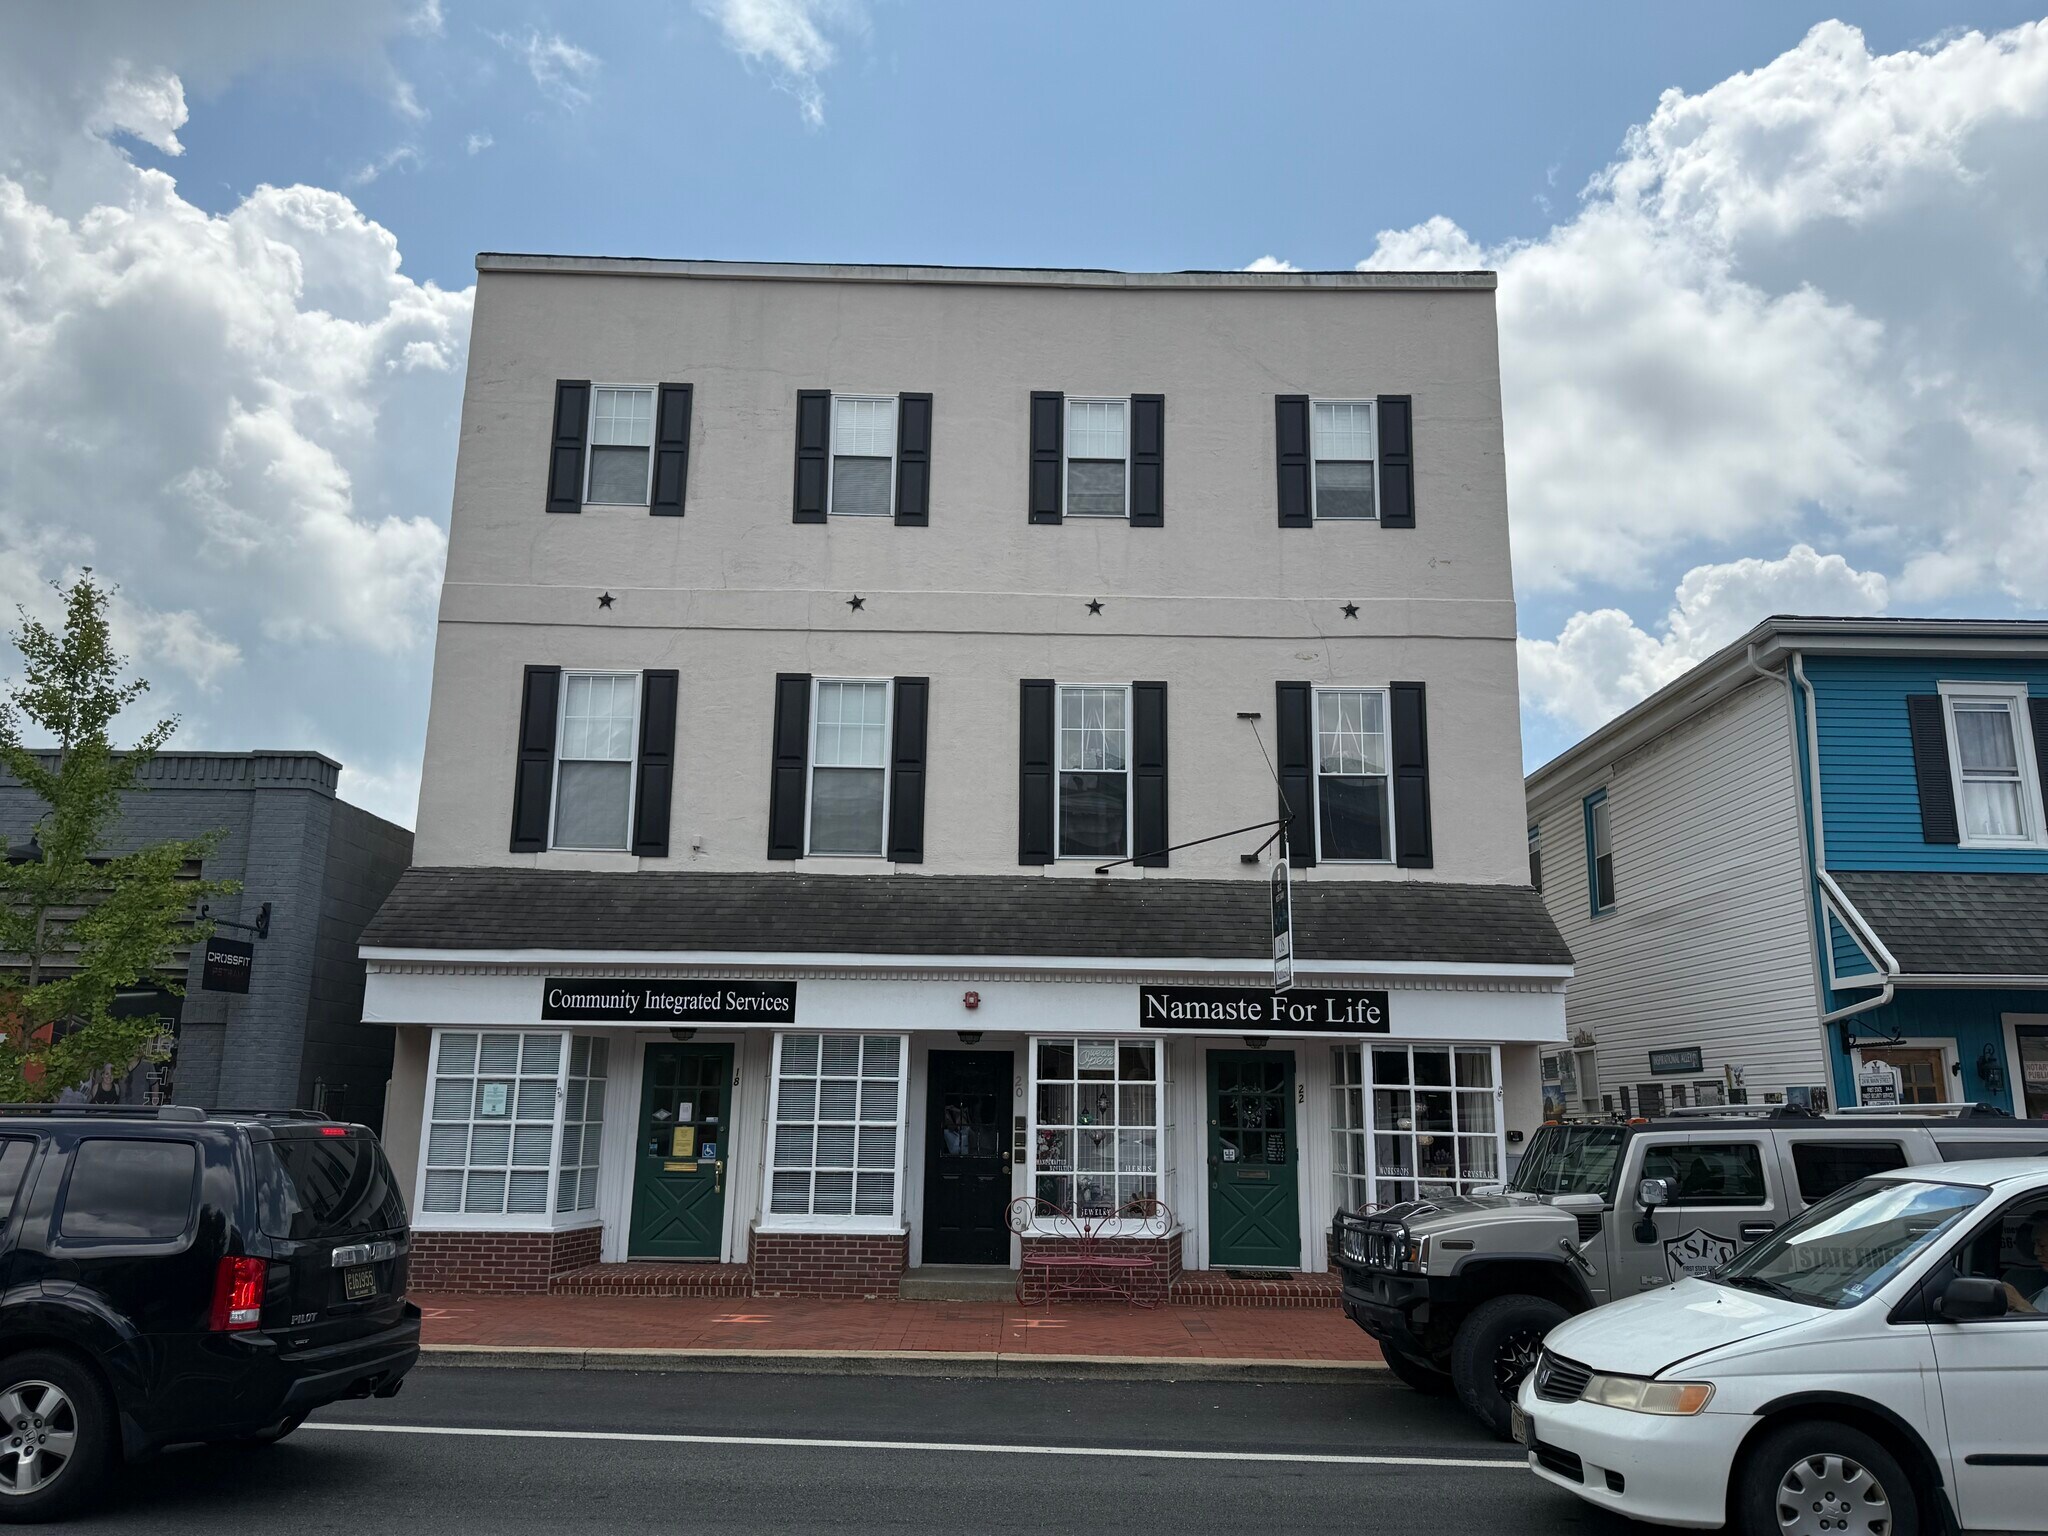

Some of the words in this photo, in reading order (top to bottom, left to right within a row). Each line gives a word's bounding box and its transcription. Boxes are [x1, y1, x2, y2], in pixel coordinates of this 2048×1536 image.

[207, 951, 251, 967] CROSSFIT
[549, 989, 640, 1014] Community
[644, 990, 721, 1014] Integrated
[726, 991, 789, 1011] Services
[1145, 994, 1262, 1020] Namaste
[1270, 996, 1317, 1022] For
[1325, 998, 1381, 1024] Life
[1079, 1050, 1115, 1069] Open
[2025, 1063, 2048, 1071] NOTAR
[2028, 1071, 2048, 1079] PUBLI
[1379, 1166, 1410, 1176] WORKSHOPS
[1462, 1169, 1495, 1178] CRYSTALS
[1668, 1239, 1732, 1268] FSFS
[291, 1312, 318, 1325] PILOT
